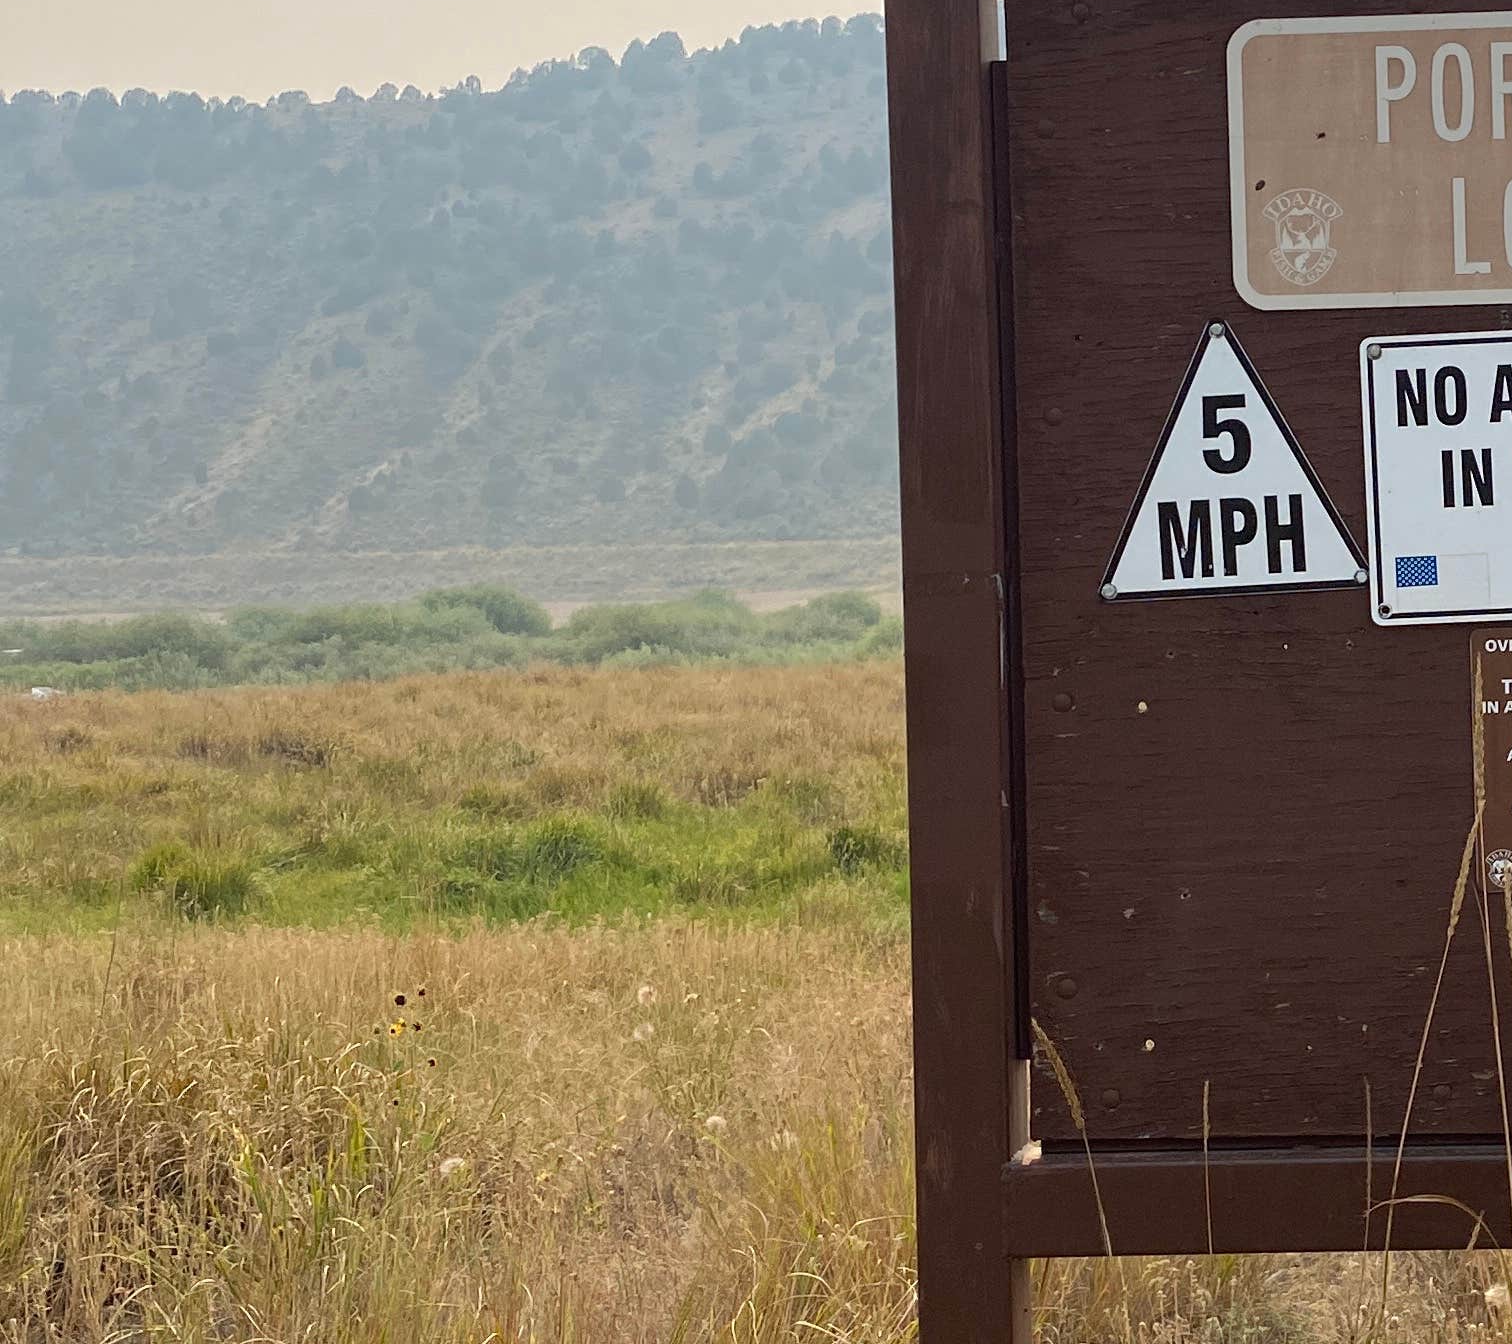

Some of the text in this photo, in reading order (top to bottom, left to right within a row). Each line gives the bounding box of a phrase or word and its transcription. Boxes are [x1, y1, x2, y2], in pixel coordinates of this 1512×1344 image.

[1267, 193, 1337, 217] IDAHO
[1396, 365, 1467, 428] NO
[1202, 394, 1252, 474] 5
[1441, 446, 1494, 508] IN
[1157, 493, 1306, 581] MPH
[1482, 700, 1499, 714] IN
